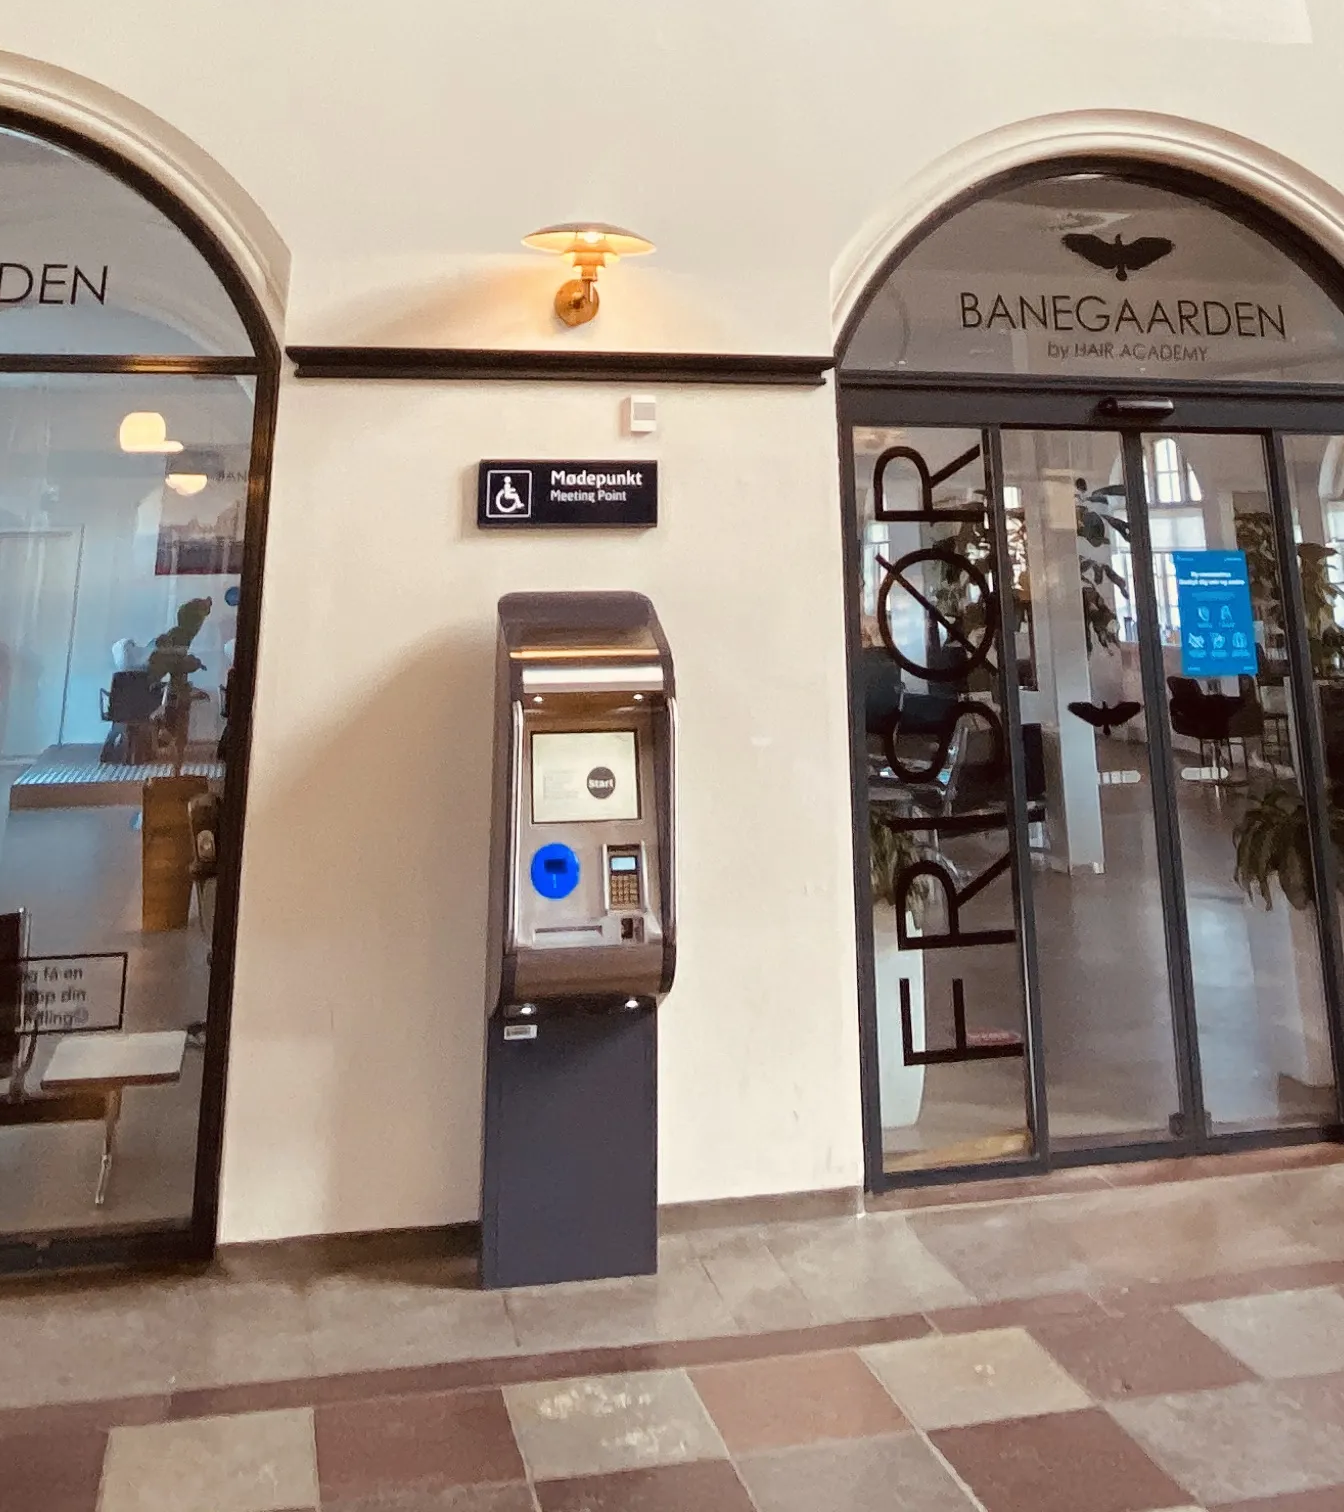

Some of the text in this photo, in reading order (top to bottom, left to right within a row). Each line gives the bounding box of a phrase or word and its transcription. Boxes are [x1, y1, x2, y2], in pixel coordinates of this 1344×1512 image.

[959, 292, 1287, 338] BANEGAARDEN
[1047, 341, 1208, 361] by HAIR ACADEMY
[550, 470, 643, 489] Mødepunkt
[550, 489, 627, 503] Meeting Point
[874, 444, 1024, 1067] FRISØR
[588, 779, 614, 789] Start
